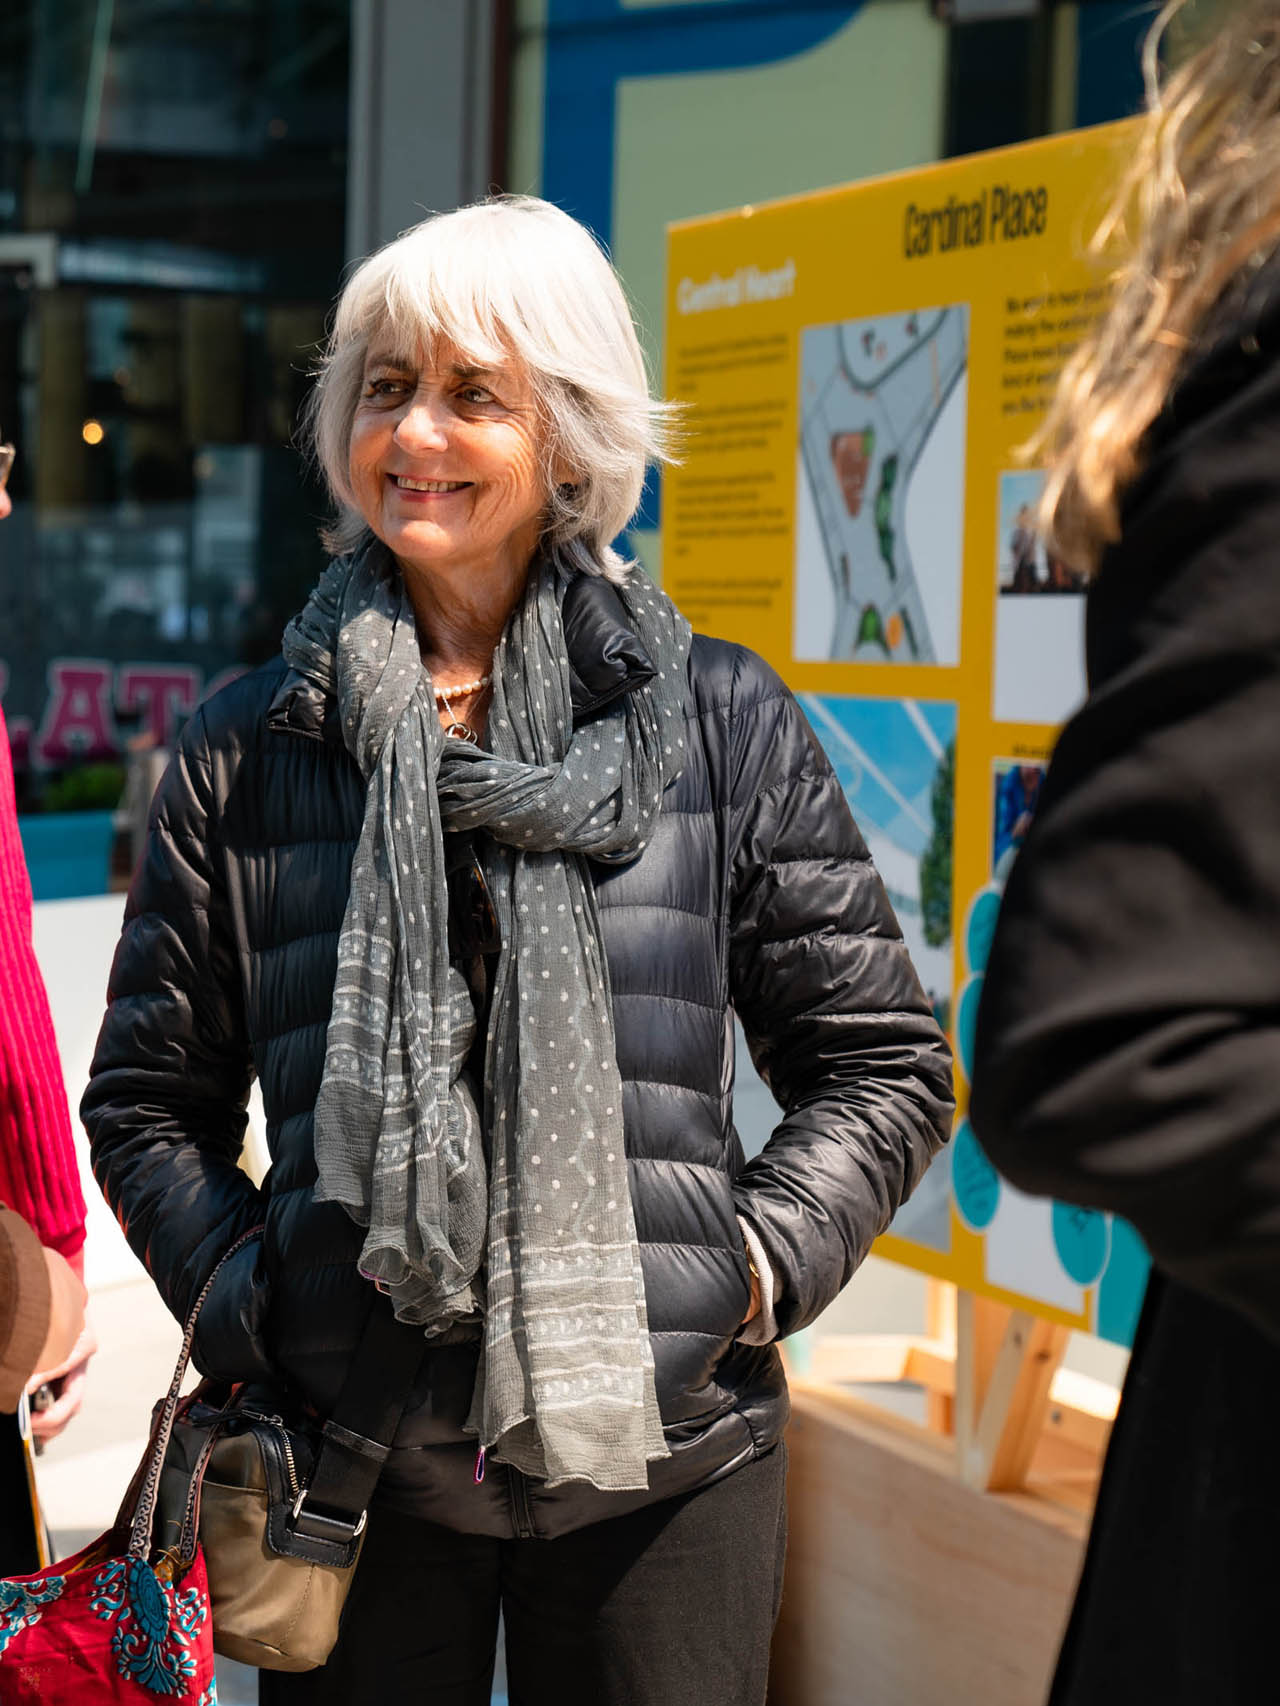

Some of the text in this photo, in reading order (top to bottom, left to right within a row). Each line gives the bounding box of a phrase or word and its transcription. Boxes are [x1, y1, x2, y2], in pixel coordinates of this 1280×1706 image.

[904, 183, 1048, 259] Cardinal Place
[677, 258, 796, 314] Central Heart
